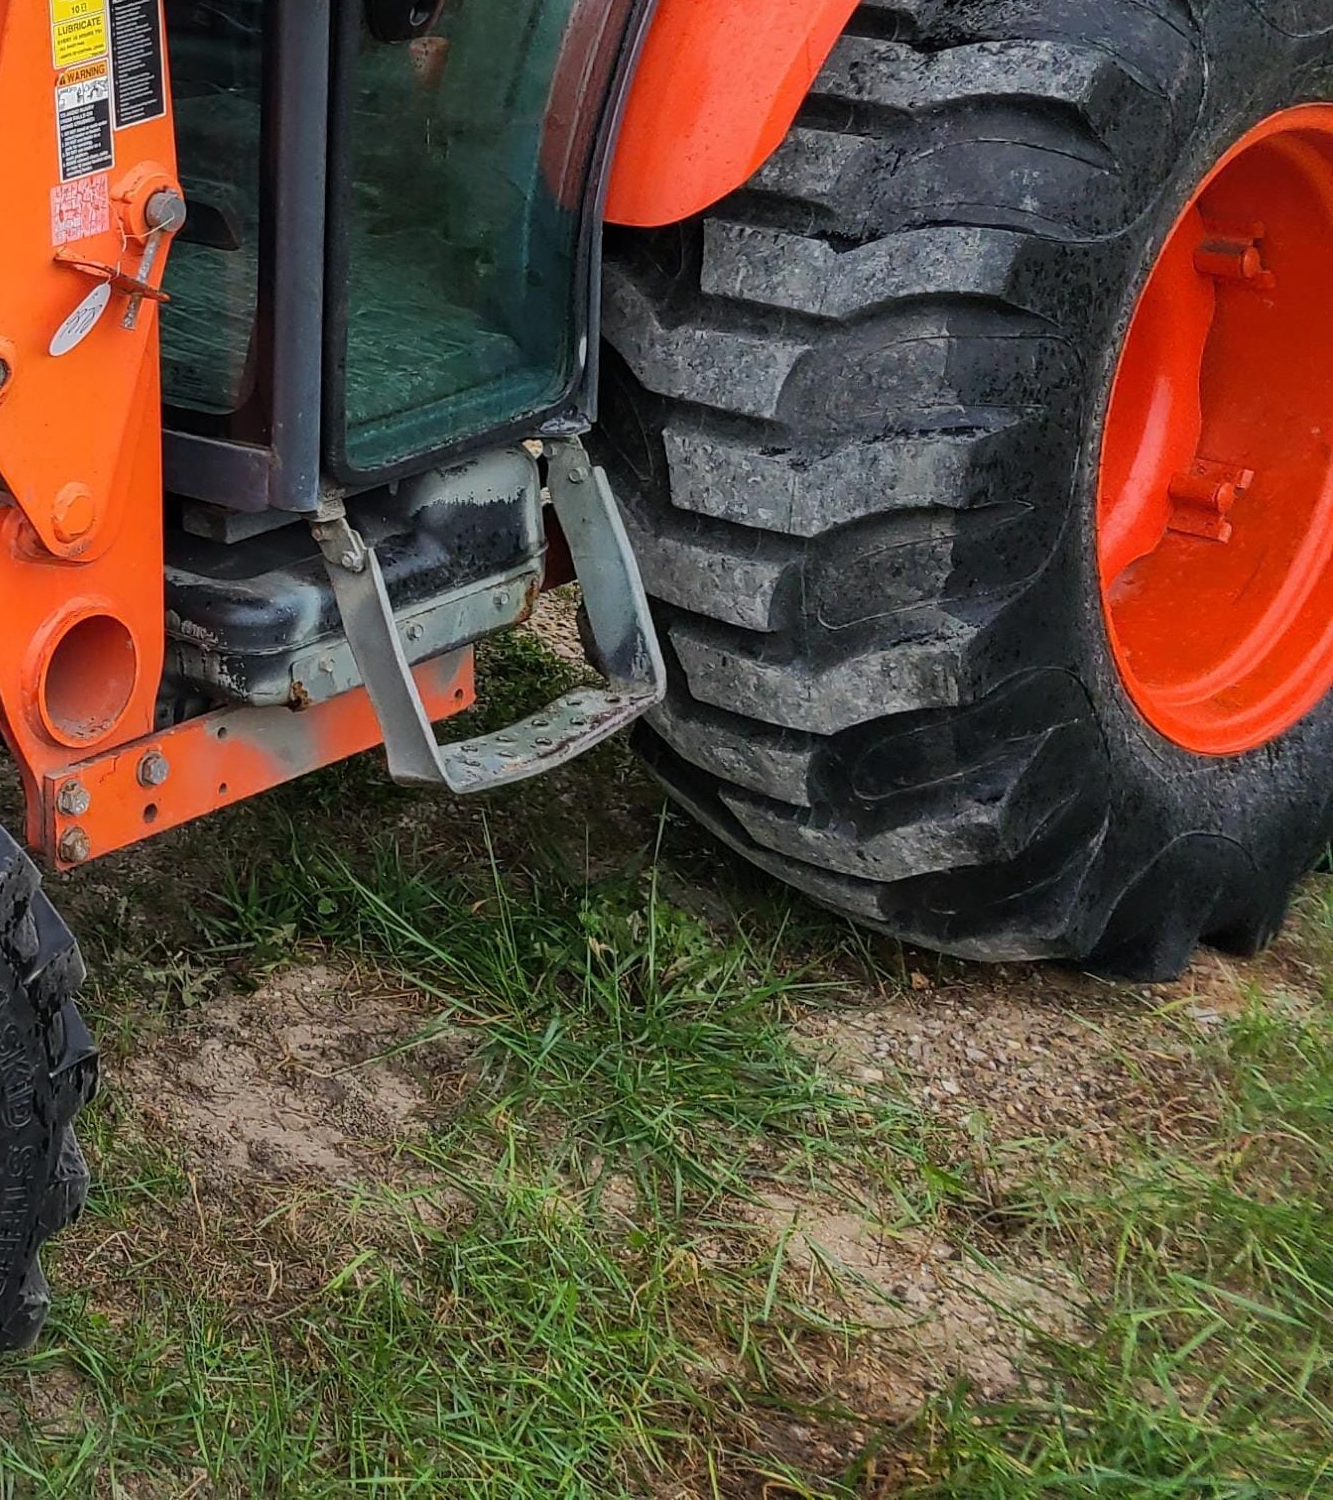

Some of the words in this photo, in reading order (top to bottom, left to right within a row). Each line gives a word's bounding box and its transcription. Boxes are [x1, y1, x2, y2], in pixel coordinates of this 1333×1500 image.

[72, 5, 80, 14] 10
[57, 16, 102, 36] LUBRICATE
[67, 64, 105, 82] WARNING
